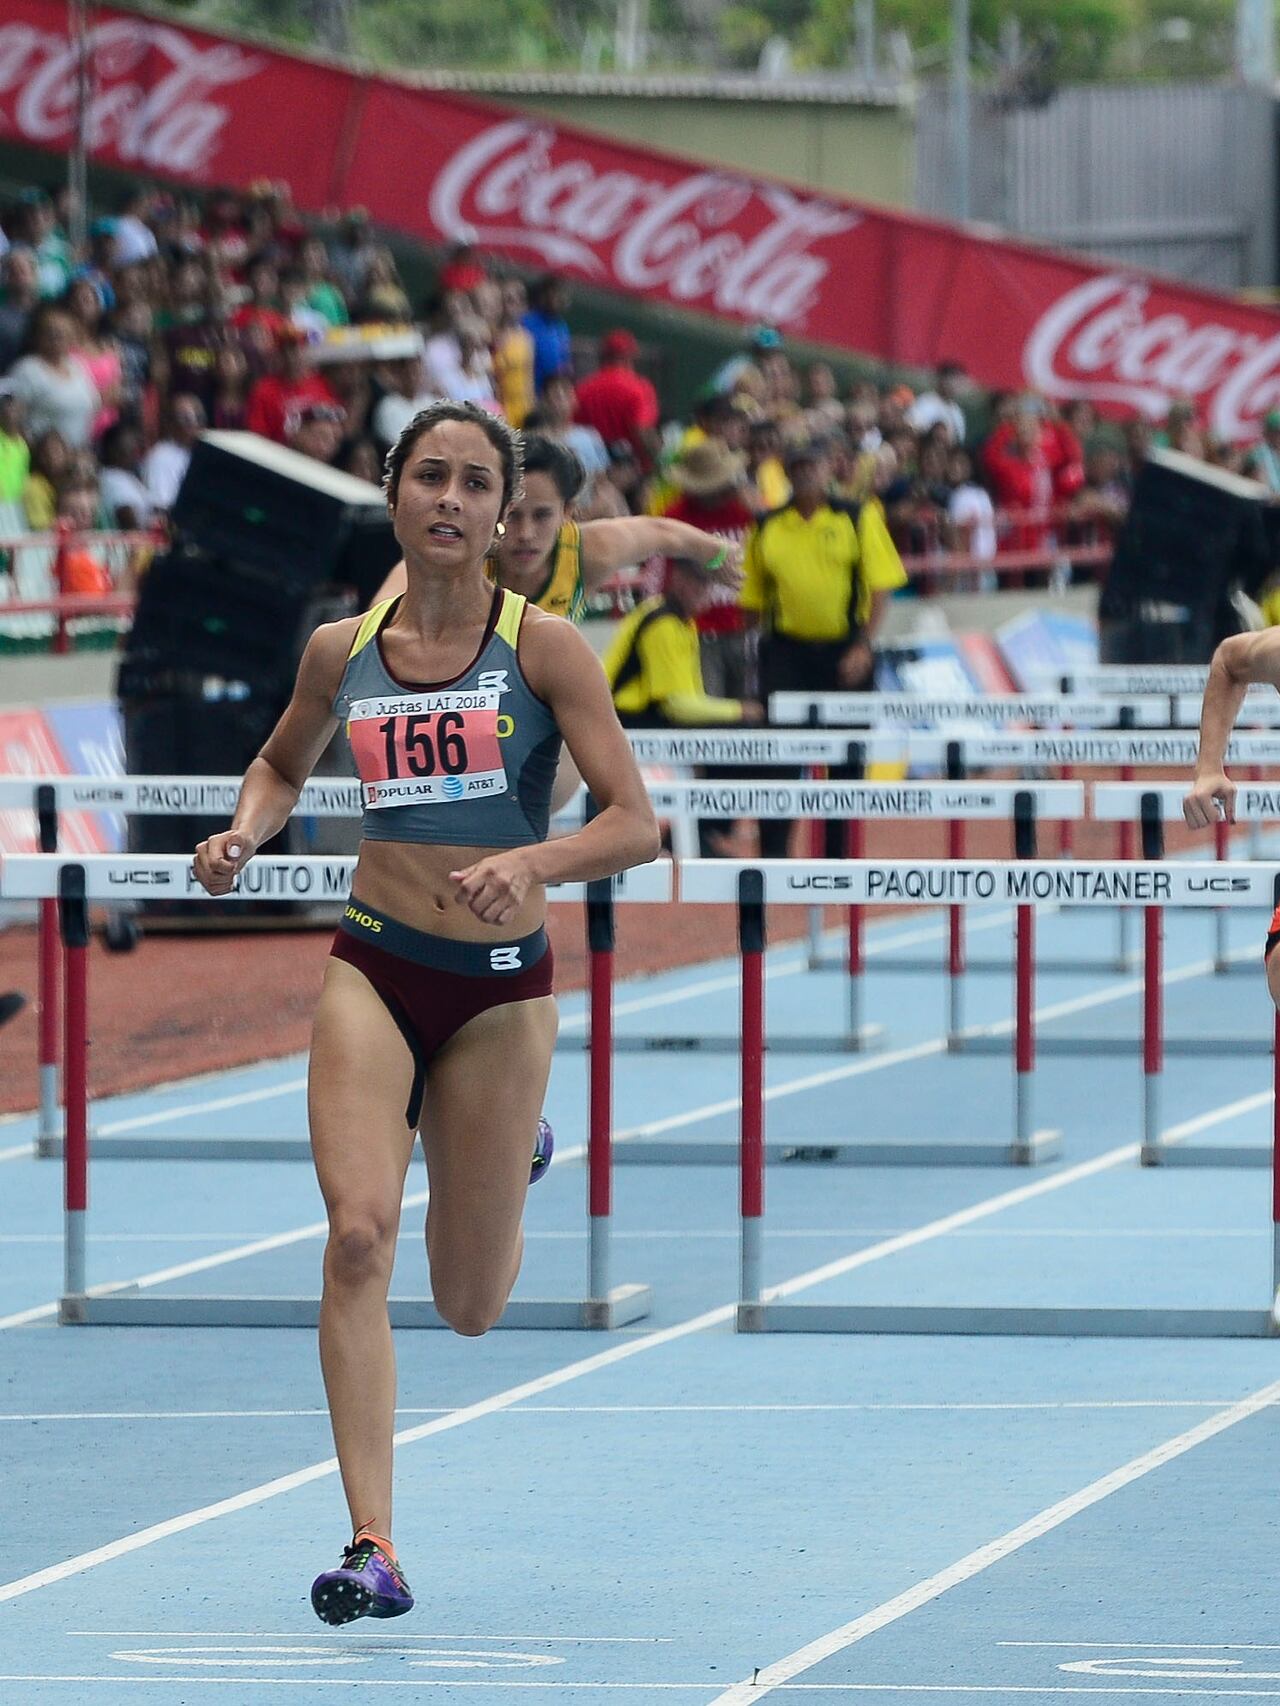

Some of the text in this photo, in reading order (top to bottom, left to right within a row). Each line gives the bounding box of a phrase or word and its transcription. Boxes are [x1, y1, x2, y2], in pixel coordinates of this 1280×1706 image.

[376, 695, 487, 715] Justas LAI 2018
[379, 711, 469, 779] 156
[467, 778, 495, 791] AT&T
[800, 789, 934, 813] MONTANER
[108, 869, 174, 885] UCS
[788, 870, 1251, 900] UCS PAQUITO MONTANER UCS
